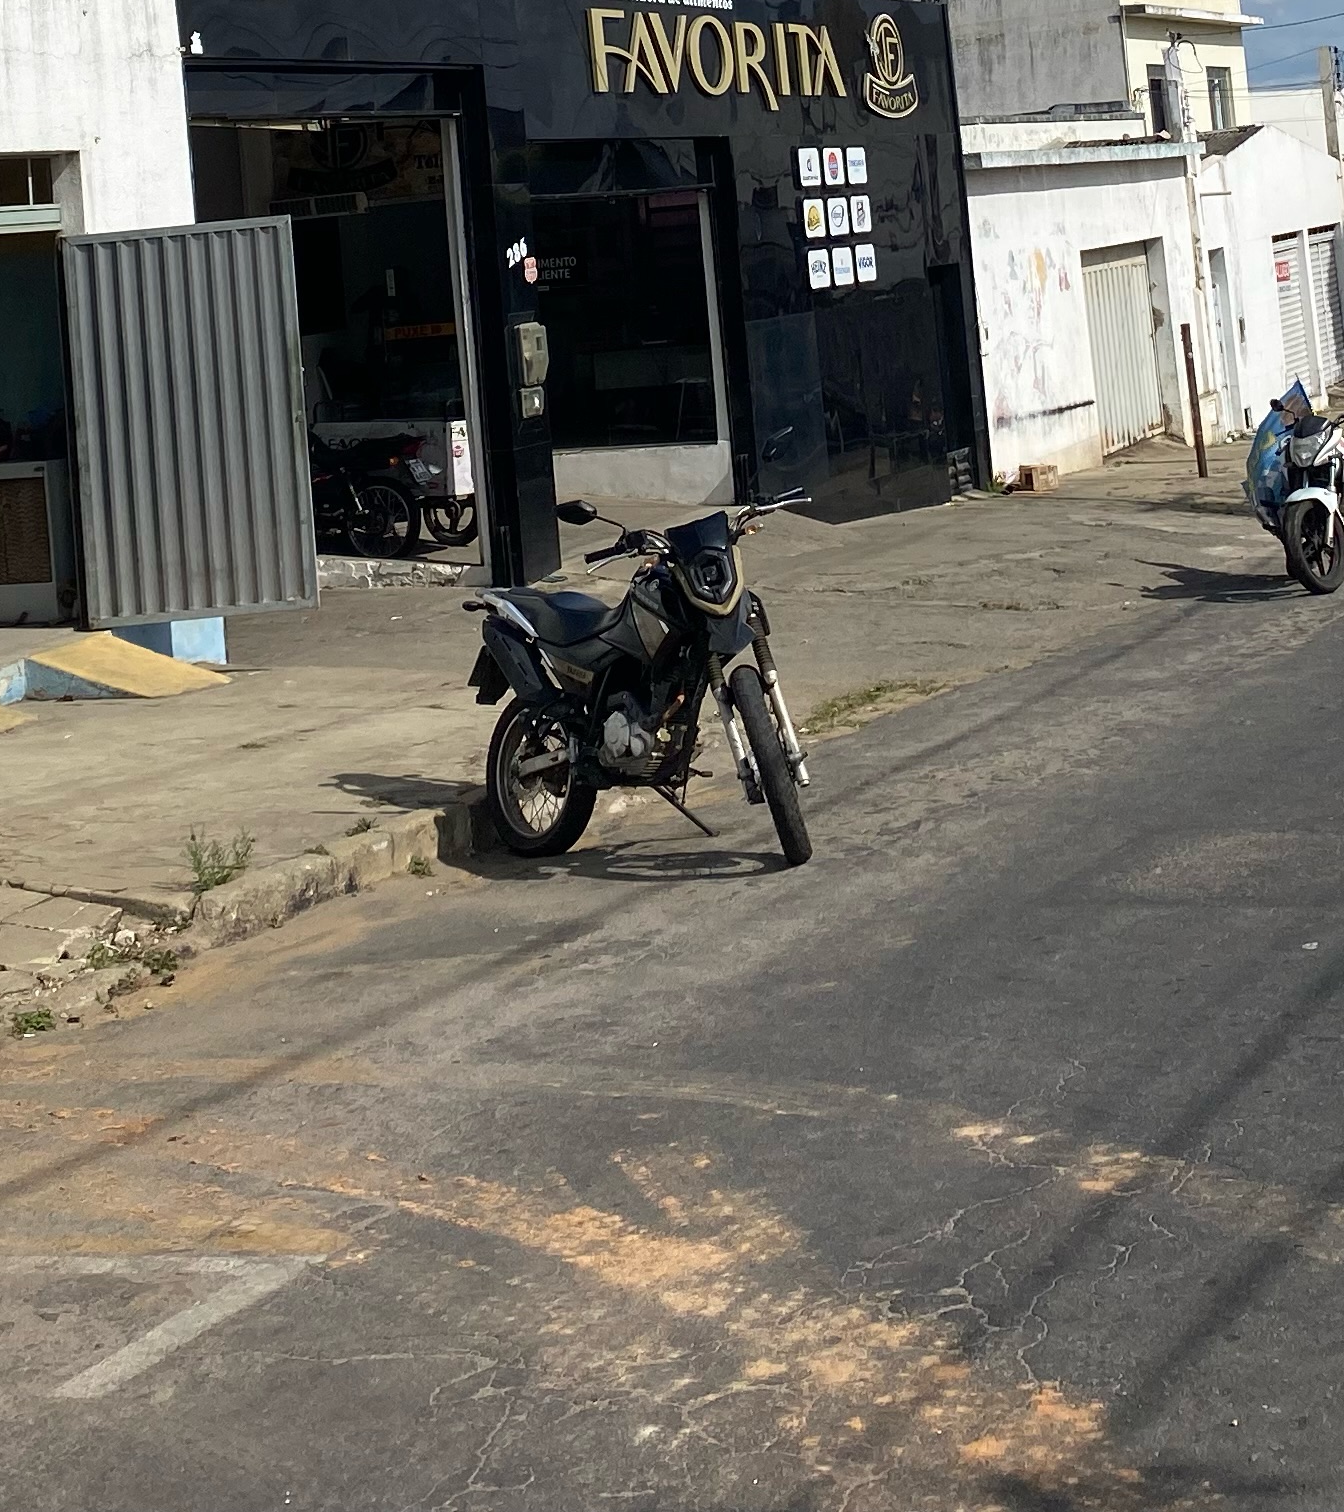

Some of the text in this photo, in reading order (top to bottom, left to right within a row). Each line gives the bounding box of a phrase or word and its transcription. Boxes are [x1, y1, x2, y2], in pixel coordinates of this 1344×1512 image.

[585, 7, 847, 111] FAVORITA
[872, 88, 914, 111] FAVORITA
[506, 236, 527, 268] 286
